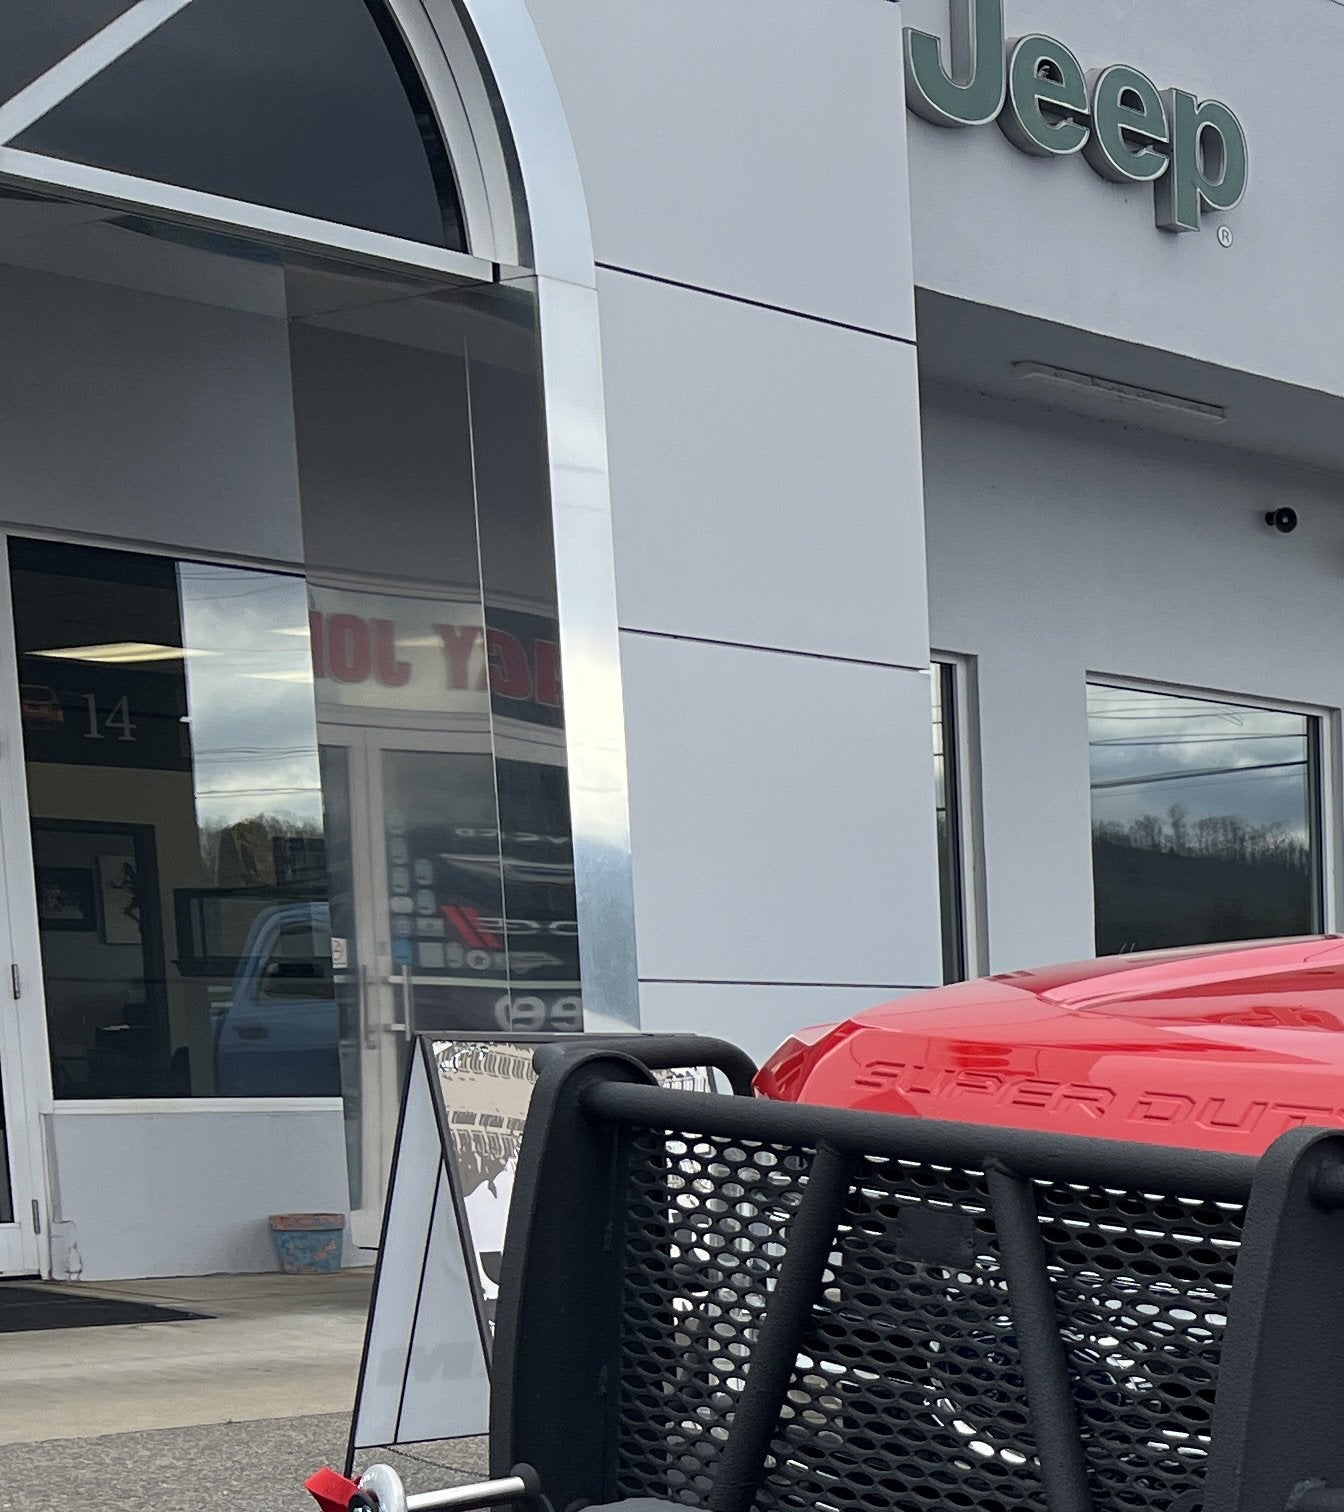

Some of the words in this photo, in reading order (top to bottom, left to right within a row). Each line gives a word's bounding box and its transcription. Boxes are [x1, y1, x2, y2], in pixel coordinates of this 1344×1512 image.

[904, 0, 1248, 232] Jeep
[80, 693, 137, 741] 14
[855, 1060, 1117, 1119] SUPER
